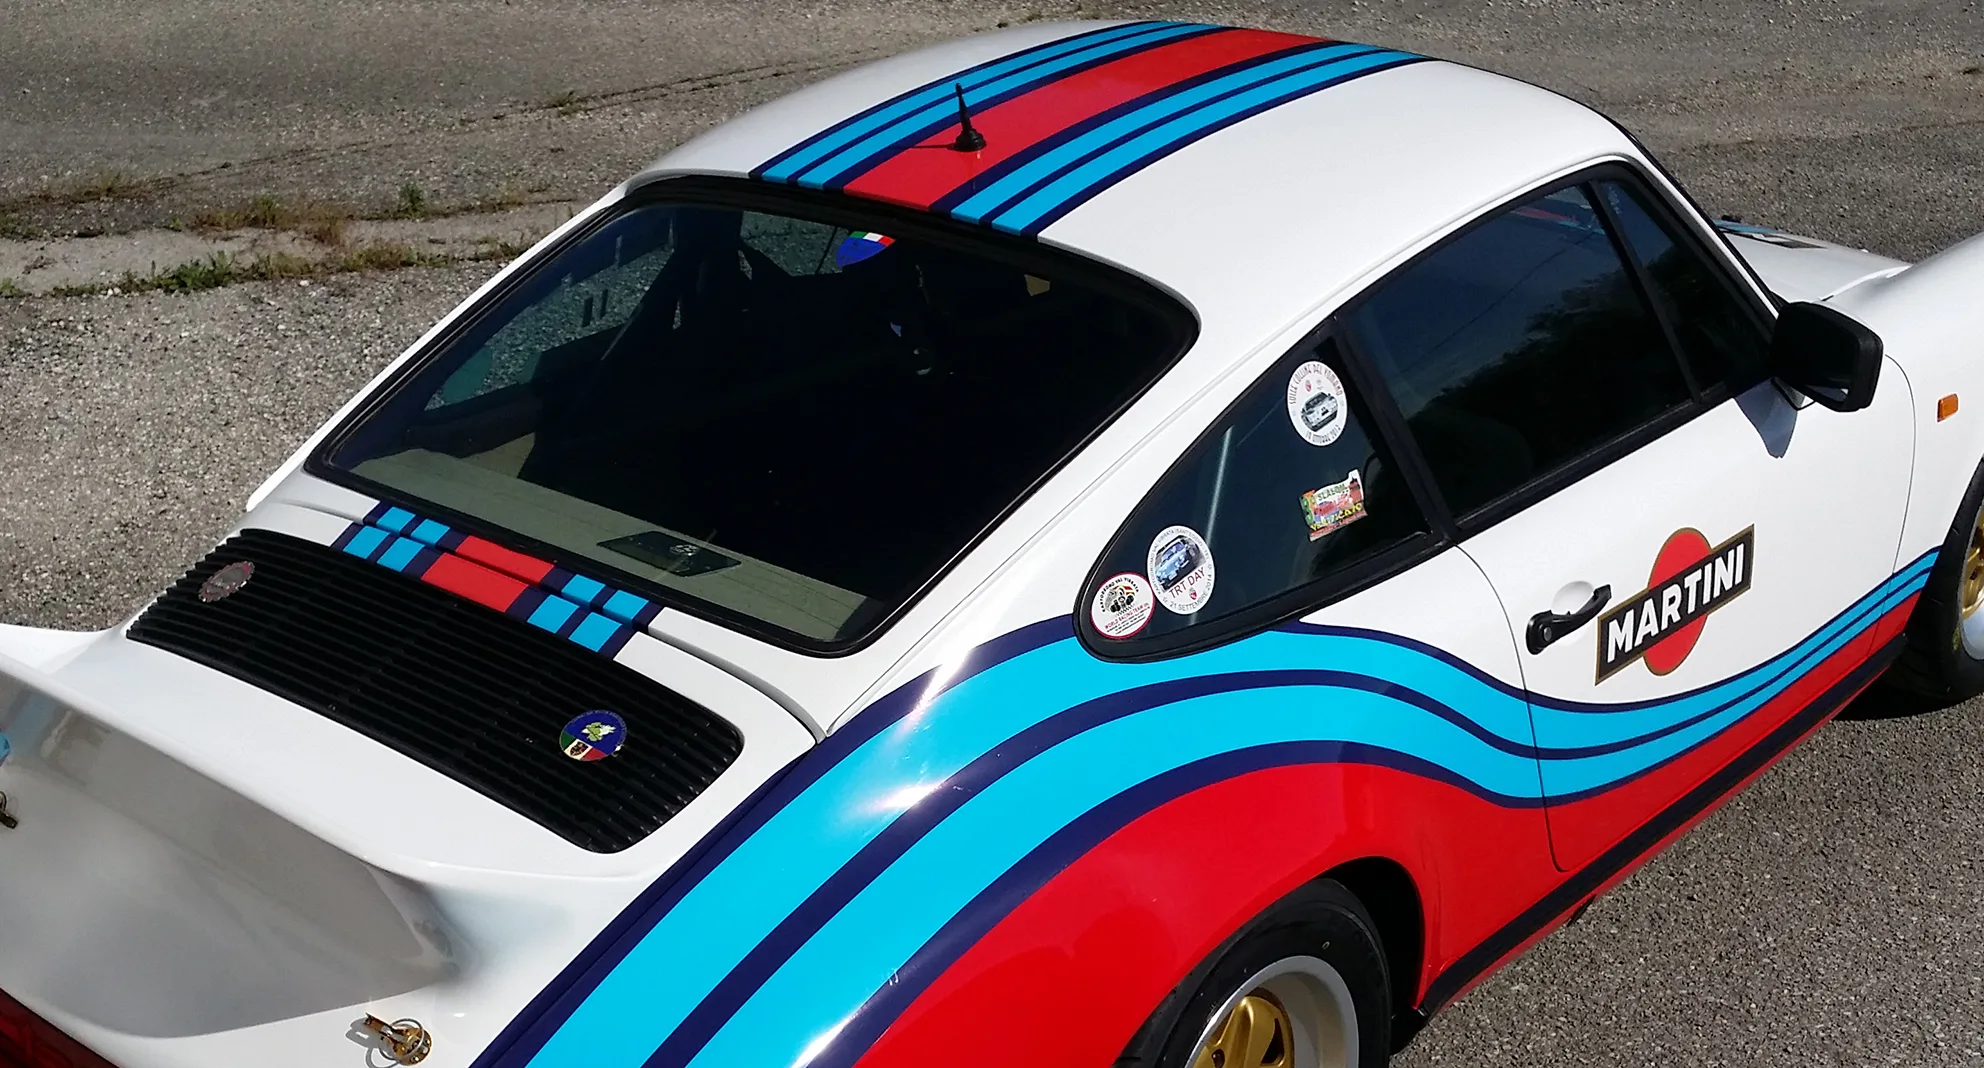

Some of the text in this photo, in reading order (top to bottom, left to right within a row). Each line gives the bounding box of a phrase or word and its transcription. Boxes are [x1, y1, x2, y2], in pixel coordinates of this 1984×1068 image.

[1169, 567, 1205, 599] TRT DAY
[1178, 592, 1208, 611] SETTEMBRE
[1607, 543, 1744, 663] MARTINI
[1105, 619, 1119, 629] WORLD
[1118, 610, 1133, 621] RACING
[1133, 605, 1143, 614] TEAM
